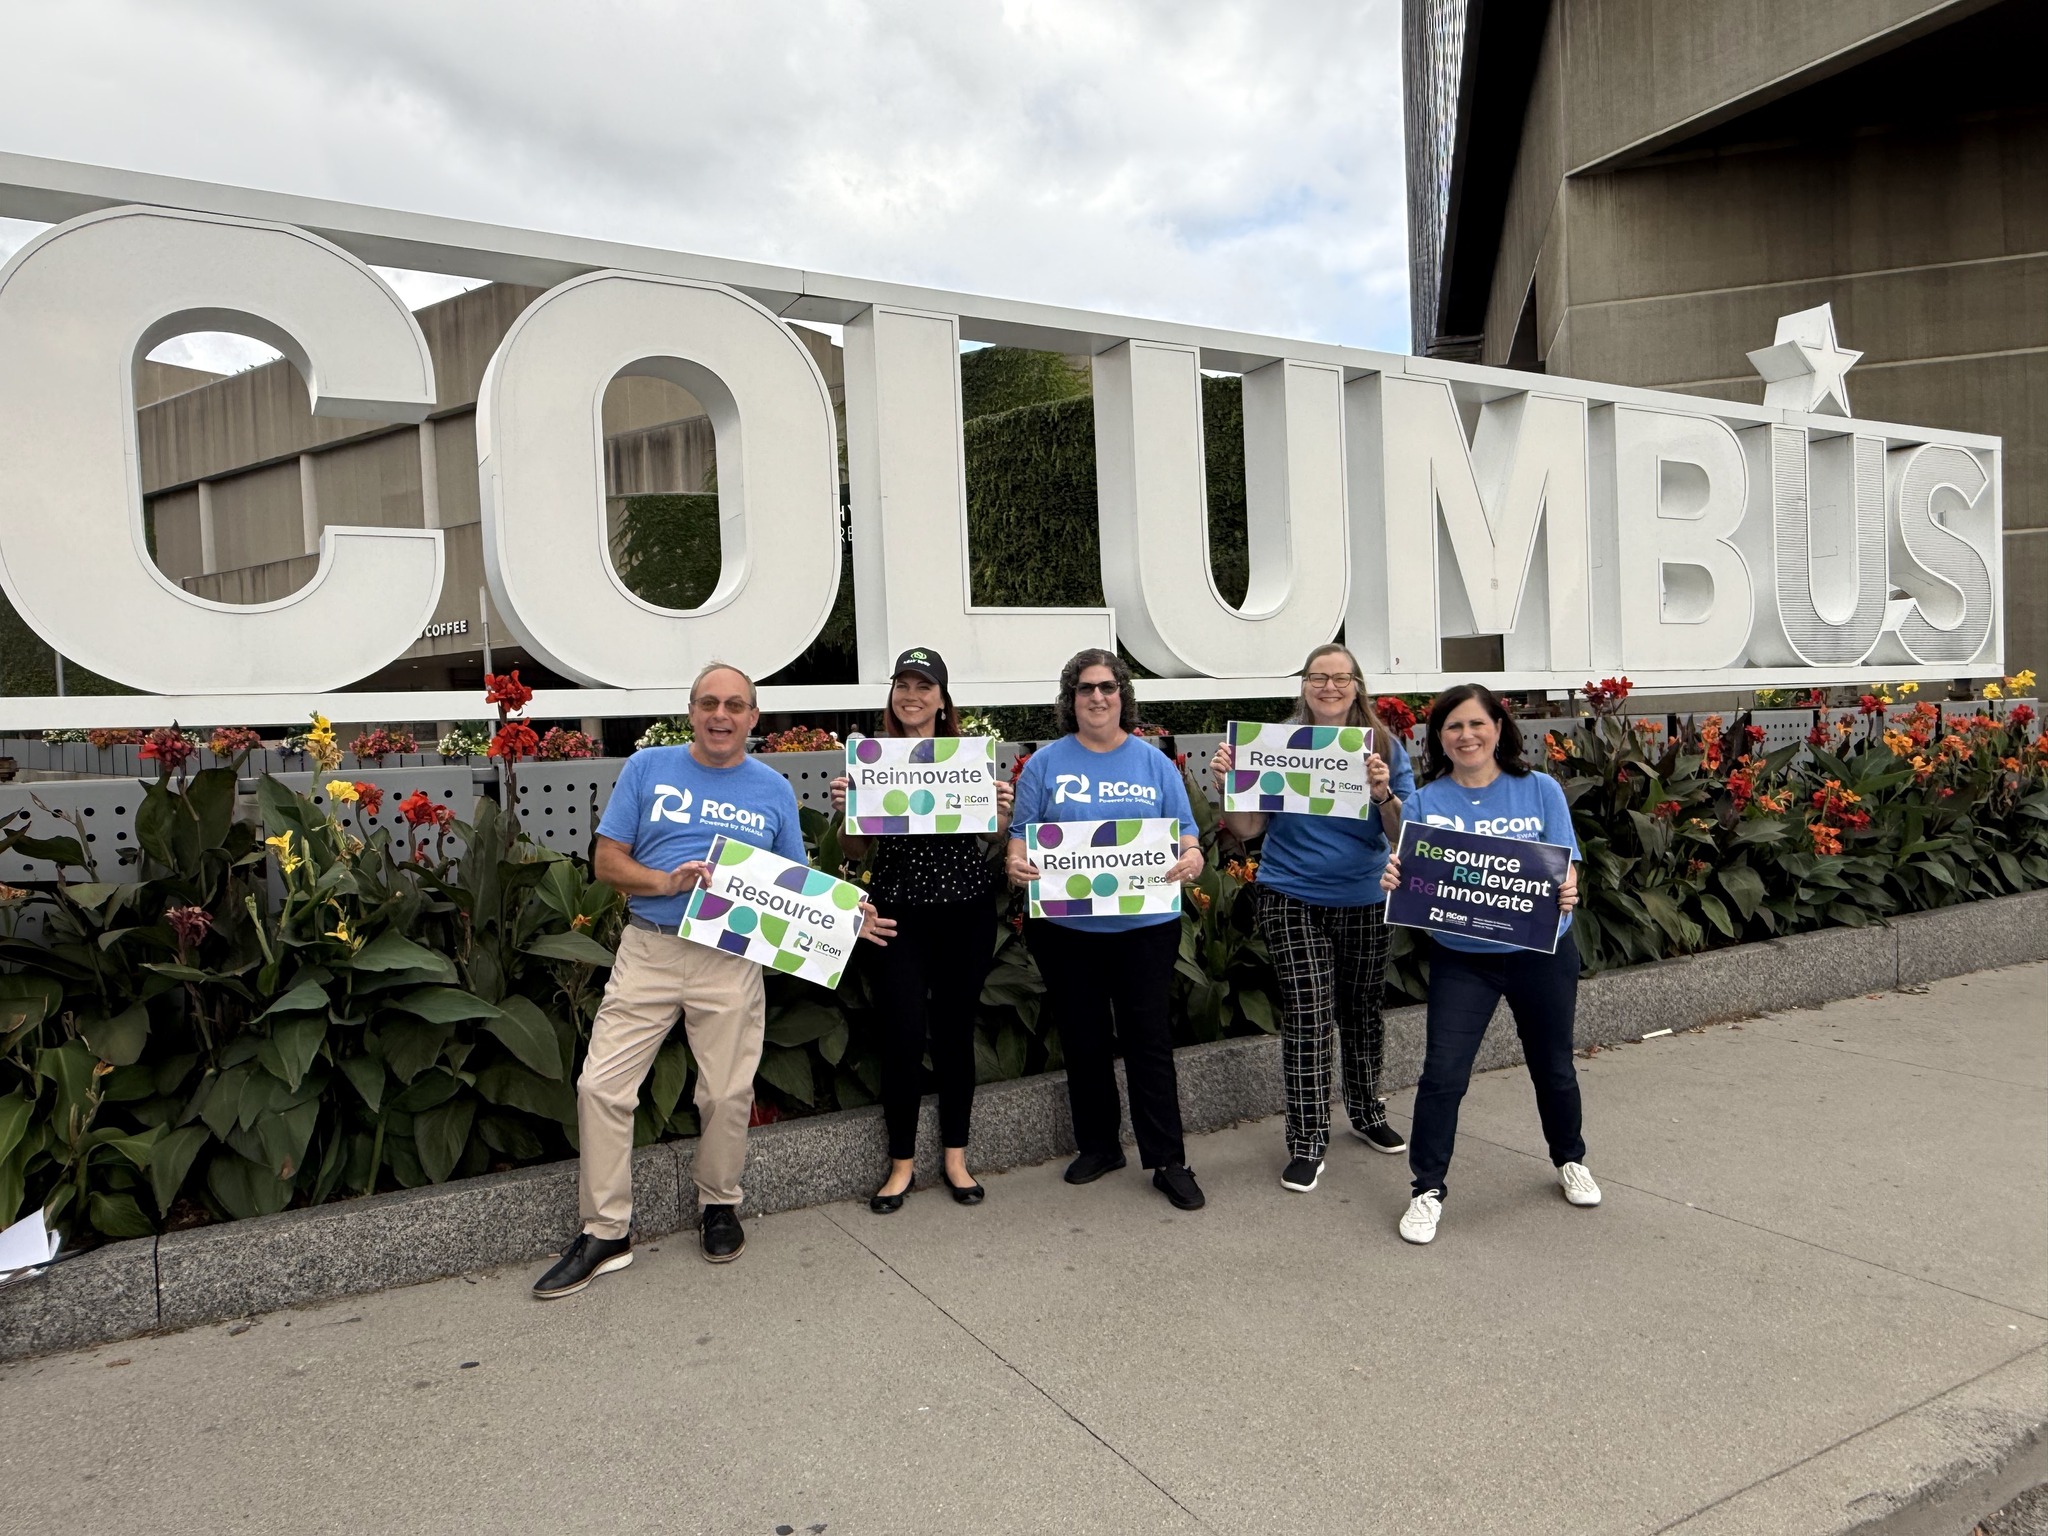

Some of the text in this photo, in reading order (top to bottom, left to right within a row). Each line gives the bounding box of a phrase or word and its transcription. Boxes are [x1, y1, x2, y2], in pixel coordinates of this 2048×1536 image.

[0, 203, 1994, 695] COLUMBUS
[425, 620, 467, 637] COFFEE
[1250, 751, 1348, 771] Resource
[861, 767, 982, 785] Reinnovate
[1098, 781, 1156, 800] RCon
[1338, 782, 1363, 791] RCon
[964, 795, 989, 804] RCon
[699, 818, 729, 829] Powered
[730, 822, 739, 831] by
[701, 799, 765, 830] RCon
[1474, 817, 1542, 837] RCon
[1043, 850, 1166, 870] Reinnovate
[1415, 840, 1521, 873] Resource
[1147, 875, 1167, 883] RCo
[1452, 865, 1551, 897] Relevant
[726, 876, 835, 930] Resource
[1409, 876, 1534, 913] Reinnovate
[815, 941, 842, 957] RCon
